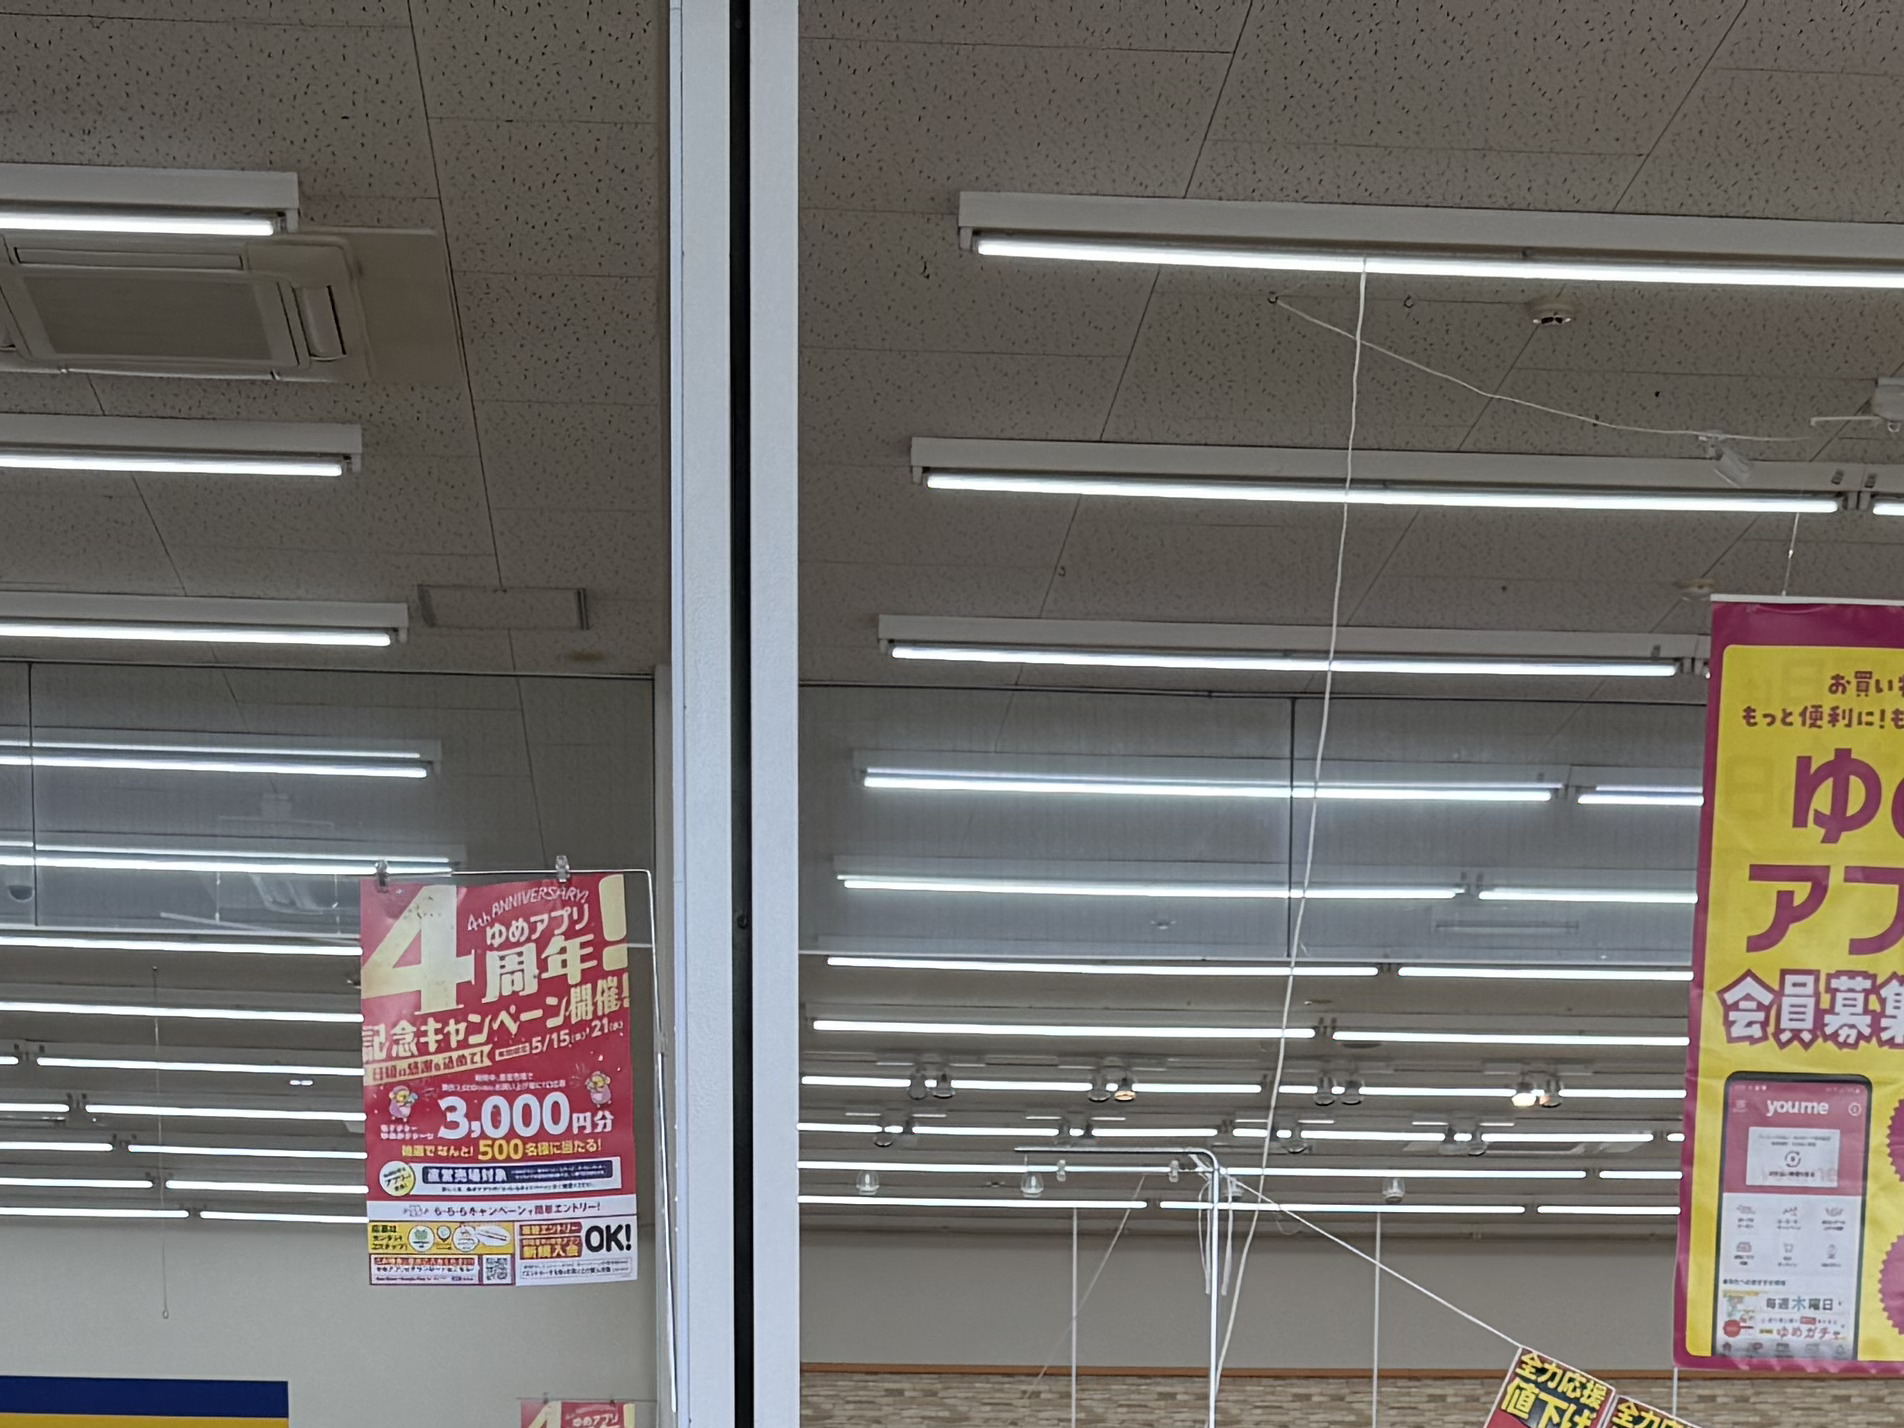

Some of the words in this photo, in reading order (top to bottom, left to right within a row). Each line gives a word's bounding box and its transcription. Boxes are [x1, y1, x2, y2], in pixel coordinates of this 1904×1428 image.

[485, 904, 590, 947] ゆめアプリ
[585, 1225, 632, 1255] OK!
[1515, 1351, 1608, 1409] 全力応援
